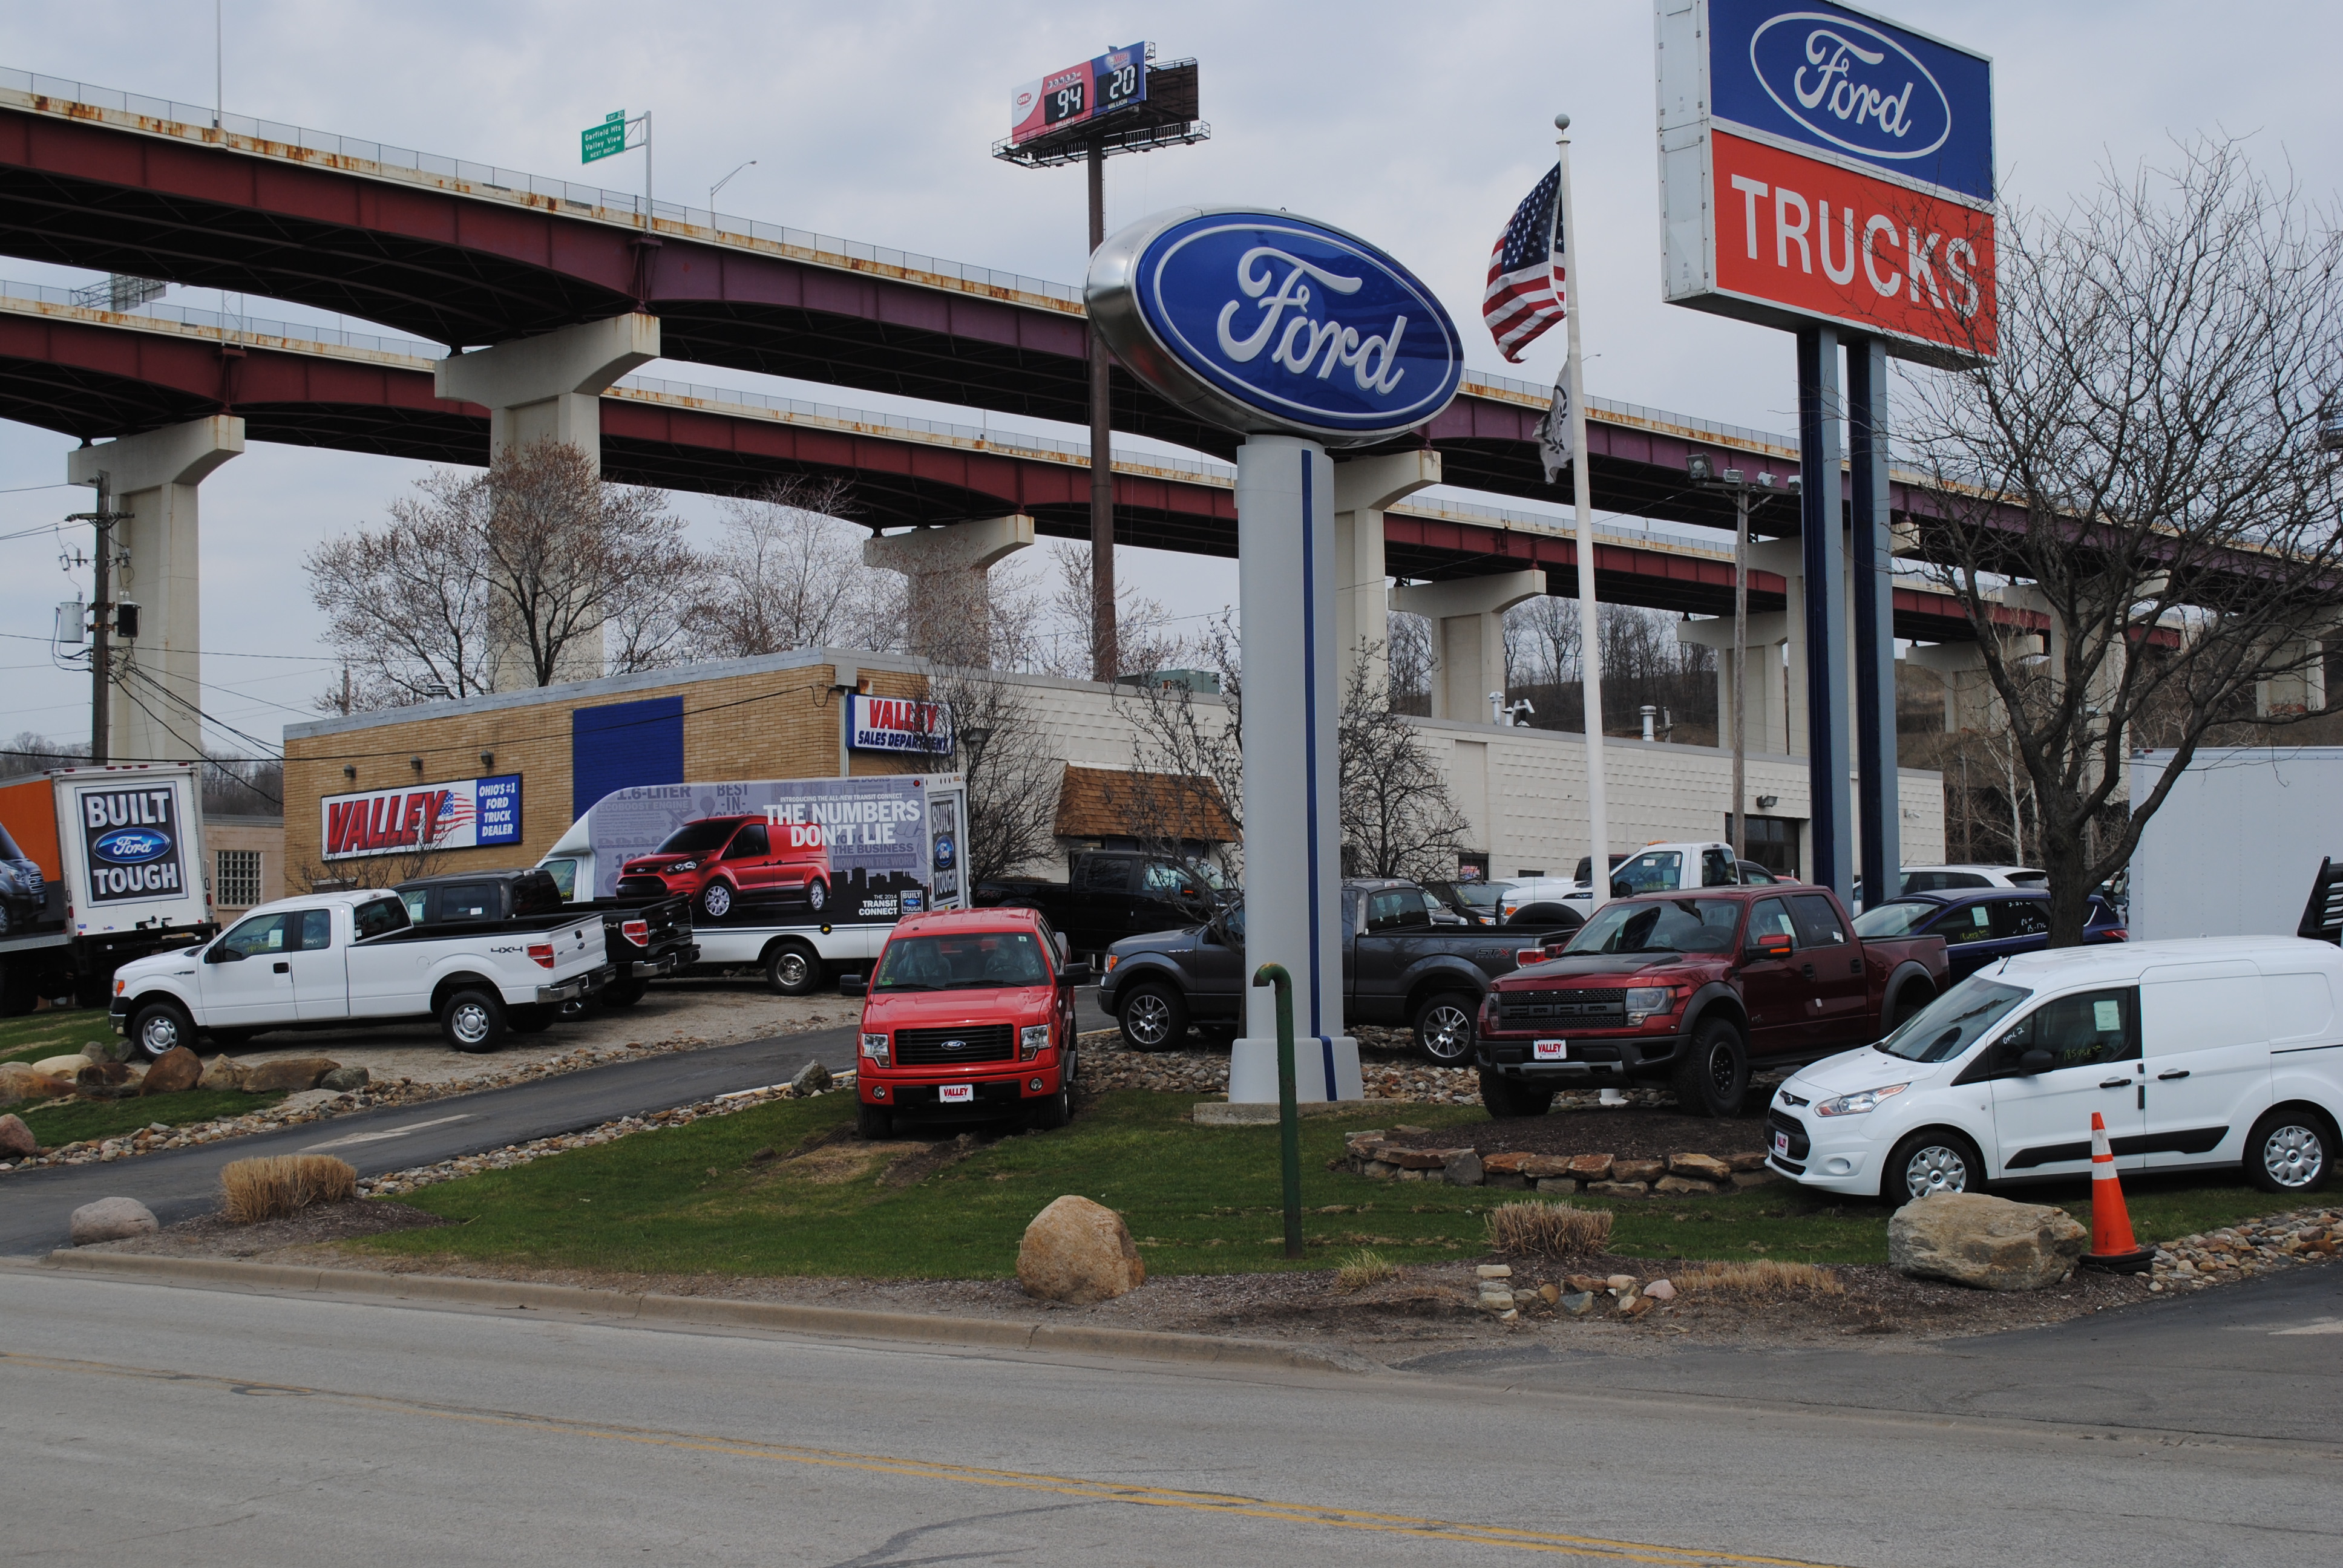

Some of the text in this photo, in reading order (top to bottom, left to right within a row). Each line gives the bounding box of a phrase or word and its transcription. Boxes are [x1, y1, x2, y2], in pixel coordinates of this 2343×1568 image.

[1048, 72, 1076, 89] POWER
[1110, 65, 1135, 99] 20
[1795, 30, 1913, 137] Ford
[1058, 86, 1081, 118] 94
[1108, 98, 1128, 109] MILLION
[585, 128, 609, 141] Garfield
[585, 136, 621, 151] Valley View
[603, 146, 616, 154] RIGHT
[1731, 174, 1979, 319] TRUCKS
[1217, 247, 1407, 396] Ford
[870, 699, 939, 733] VALLEY
[858, 731, 948, 751] SALES DEPARTENT
[479, 782, 516, 797] OHIO'S #1
[617, 786, 692, 800] 1.6-LITER
[717, 784, 748, 796] BEST
[87, 792, 169, 828] BUILT
[486, 797, 509, 809] FORD
[600, 800, 689, 812] ECOBOOST ENGINE
[484, 810, 511, 823] TRUCK
[764, 800, 920, 825] THE NUMBERS
[932, 803, 954, 835] BUILT
[327, 789, 449, 854] VALLEY
[482, 823, 513, 837] DEALER
[791, 823, 896, 847] DON'T LIE
[113, 836, 152, 855] Ford
[833, 843, 914, 854] THE BUSINESS
[835, 855, 916, 868] NOW OWN THE WORK
[93, 863, 179, 894] TOUGH
[935, 869, 957, 895] TOUGH
[862, 900, 897, 908] TRANSIT
[1477, 947, 1512, 957] STX
[1538, 1044, 1561, 1053] VALLEY
[943, 1088, 968, 1097] VALLEY
